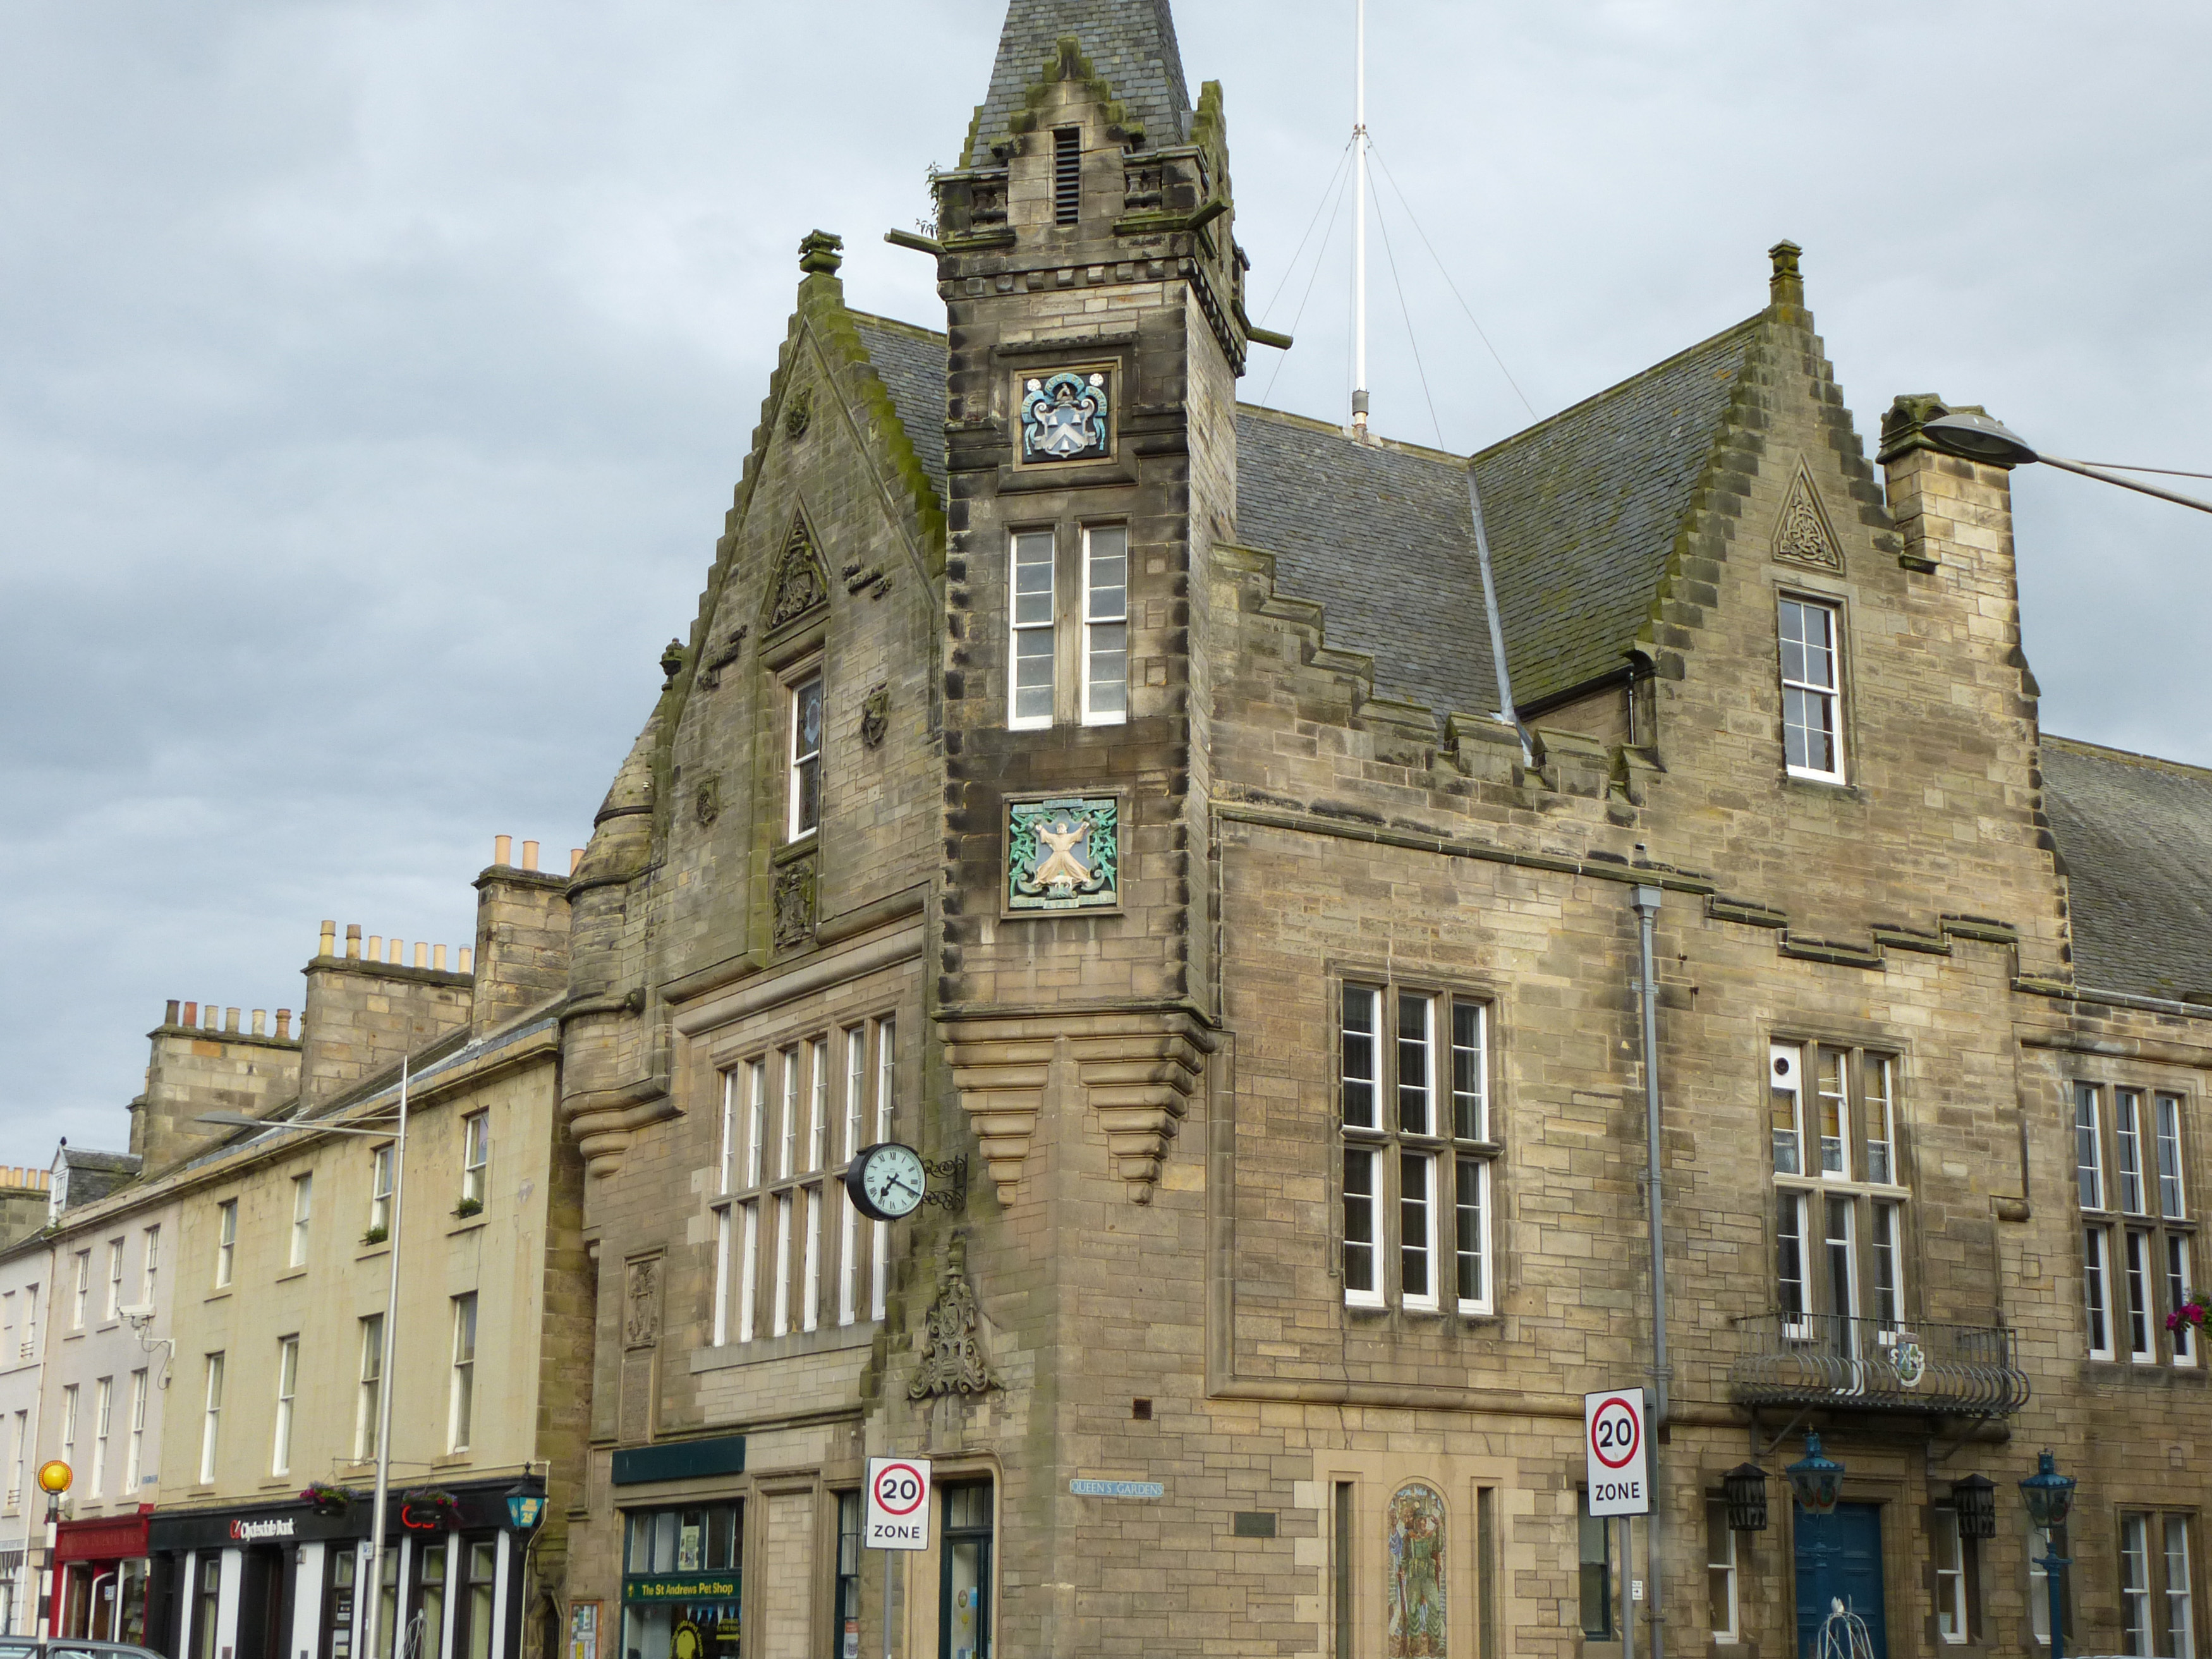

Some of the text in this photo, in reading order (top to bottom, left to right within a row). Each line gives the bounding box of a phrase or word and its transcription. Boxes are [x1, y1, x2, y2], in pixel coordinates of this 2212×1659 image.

[1598, 1418, 1632, 1448] 20
[882, 1478, 917, 1500] 20
[1116, 1483, 1163, 1496] GARDENS
[1595, 1481, 1641, 1502] ZONE
[874, 1524, 920, 1539] ZONE
[642, 1582, 734, 1596] The St Andrews Pet Shop
